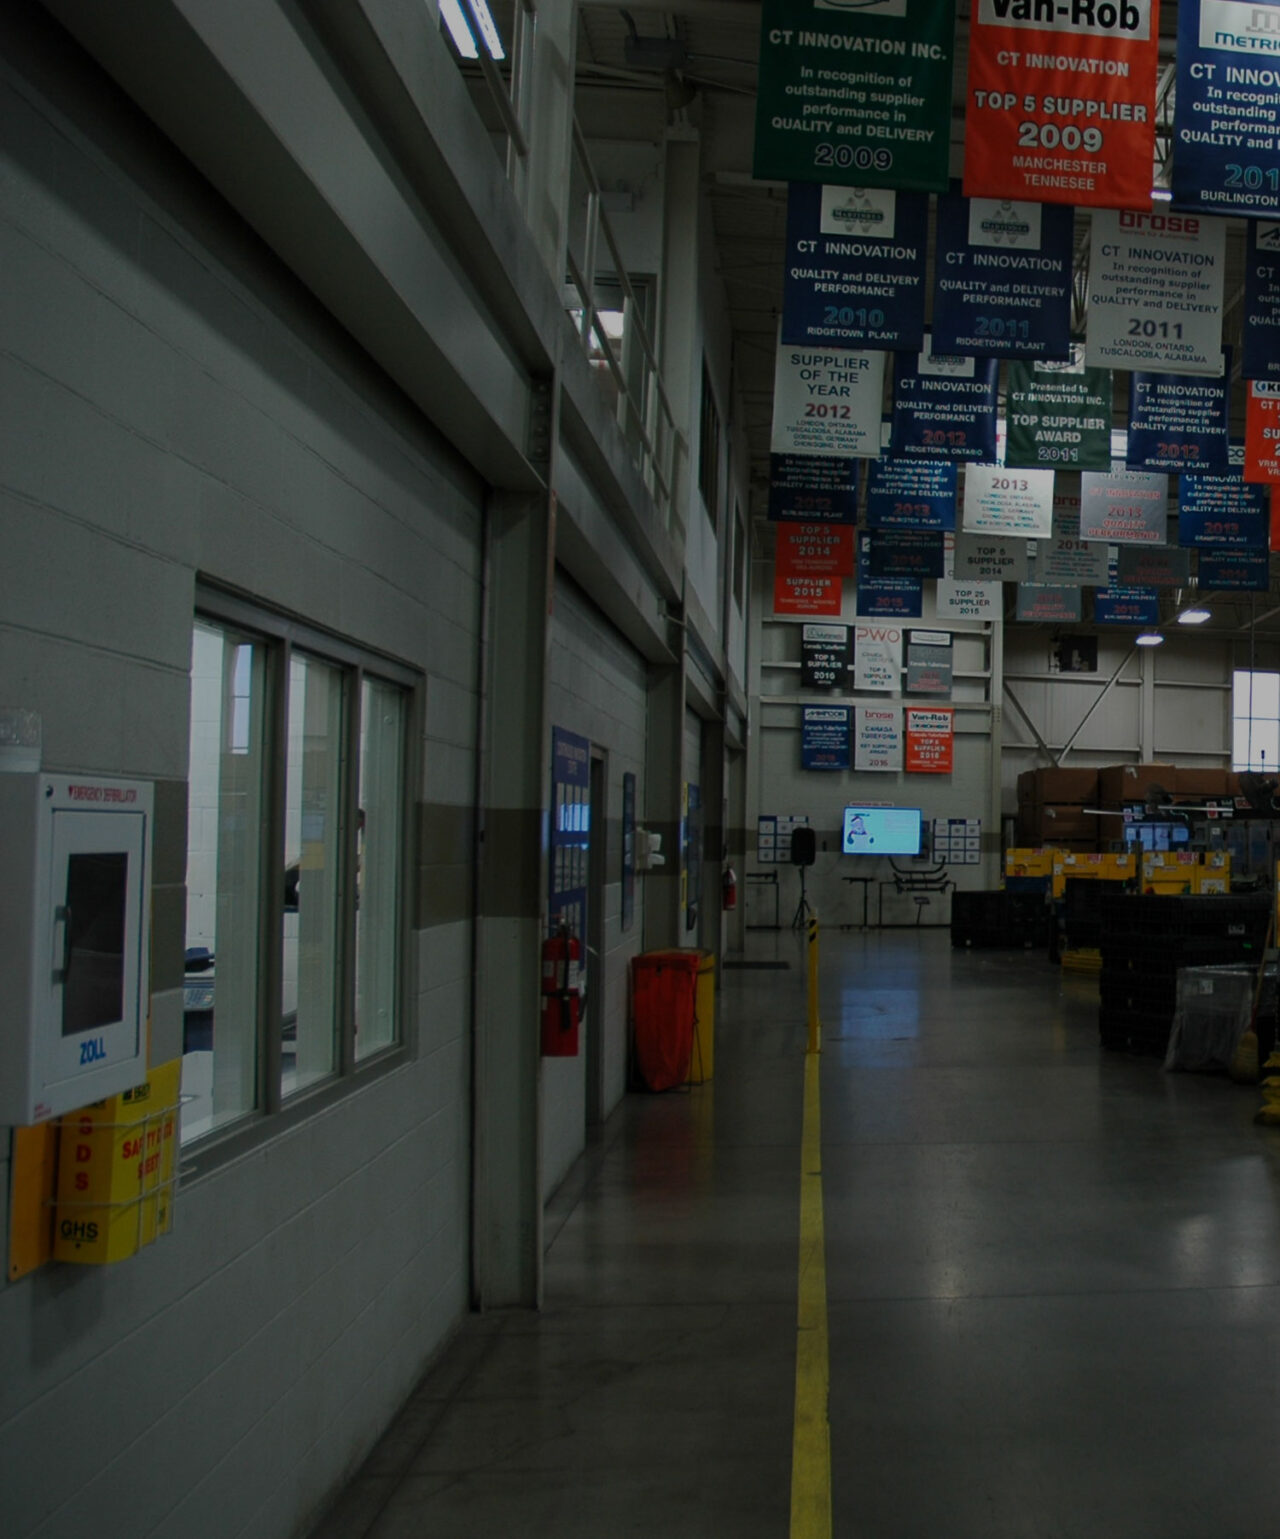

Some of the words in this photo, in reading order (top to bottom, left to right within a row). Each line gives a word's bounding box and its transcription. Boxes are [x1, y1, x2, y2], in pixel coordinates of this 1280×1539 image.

[769, 29, 792, 45] CT
[798, 32, 906, 56] INNOVATION
[911, 43, 947, 61] INC.
[997, 52, 1021, 66] CT
[1026, 54, 1128, 76] INNOVATION
[1190, 63, 1215, 79] CT
[801, 66, 813, 78] In
[818, 69, 894, 86] recognition
[899, 75, 912, 87] of
[785, 84, 866, 103] outstanding
[871, 91, 925, 107] supplier
[1207, 86, 1222, 98] In
[803, 103, 889, 123] performance
[894, 111, 906, 122] in
[975, 90, 1016, 109] TOP
[1024, 96, 1035, 112] 5
[1043, 97, 1146, 123] SUPPLIER
[1193, 101, 1276, 122] outstanding
[772, 117, 832, 134] QUALITY
[837, 124, 862, 136] and
[866, 124, 935, 143] DELIVERY
[1018, 122, 1103, 153] 2009
[1180, 129, 1242, 147] QUALITY
[1247, 136, 1272, 149] and
[814, 144, 893, 171] 2009
[1013, 156, 1106, 175] MANCHESTER
[1024, 174, 1094, 191] TENNESEE
[1201, 190, 1277, 207] BURLINGTON
[797, 241, 818, 254] CT
[825, 241, 916, 260] INNOVATION
[1102, 245, 1120, 257] CT
[1128, 246, 1214, 266] INNOVATION
[946, 252, 965, 265] CT
[973, 254, 1062, 272] INNOVATION
[791, 267, 839, 282] QUALITY
[843, 271, 862, 282] and
[865, 271, 919, 286] DELIVERY
[814, 282, 895, 297] PERFORMANCE
[824, 305, 885, 327] 2010
[807, 327, 865, 339] RIDGETOWN
[868, 330, 899, 340] PLANT
[975, 317, 1029, 337] 2011
[1128, 318, 1184, 340] 2011
[1113, 339, 1153, 352] LONDON,
[1158, 341, 1193, 353] ONTARIO
[791, 354, 869, 369] SUPPLIER
[800, 370, 821, 380] OF
[828, 371, 858, 383] THE
[808, 384, 850, 397] YEAR
[805, 404, 850, 419] 2012
[1012, 414, 1038, 425] TOP
[1042, 417, 1105, 429] SUPPLIER
[922, 429, 967, 445] 2012
[1035, 431, 1081, 443] AWARD
[1038, 447, 1078, 461] 2011
[1157, 443, 1200, 459] 2012
[992, 479, 1028, 491] 2013
[799, 547, 830, 556] 2014
[794, 588, 822, 596] 2015
[857, 628, 899, 643] PWO
[80, 1040, 105, 1064] ZOLL
[61, 1220, 98, 1238] GHS
